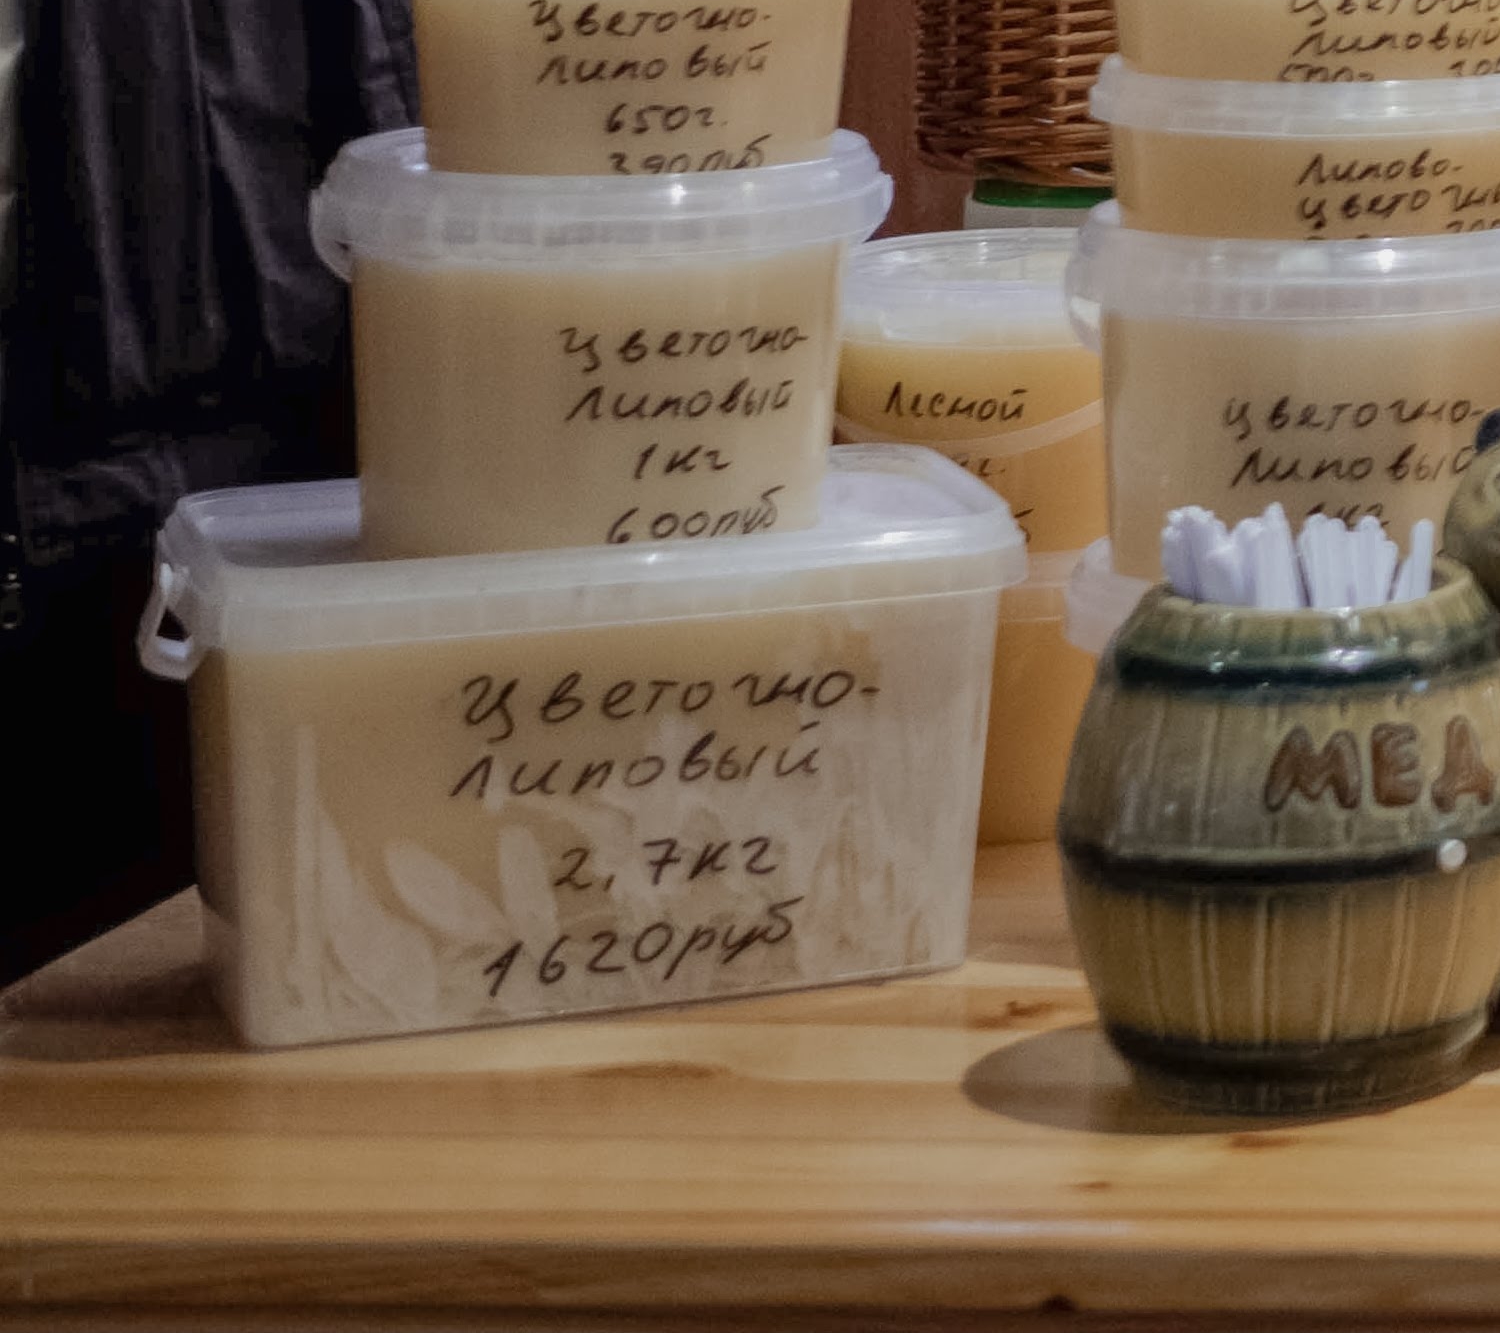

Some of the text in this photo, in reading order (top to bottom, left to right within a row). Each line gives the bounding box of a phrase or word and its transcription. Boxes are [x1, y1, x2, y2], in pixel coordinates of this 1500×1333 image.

[460, 667, 880, 742] Цветочно-
[1262, 716, 1497, 814] МЕД
[482, 897, 805, 1000] 1620руб
